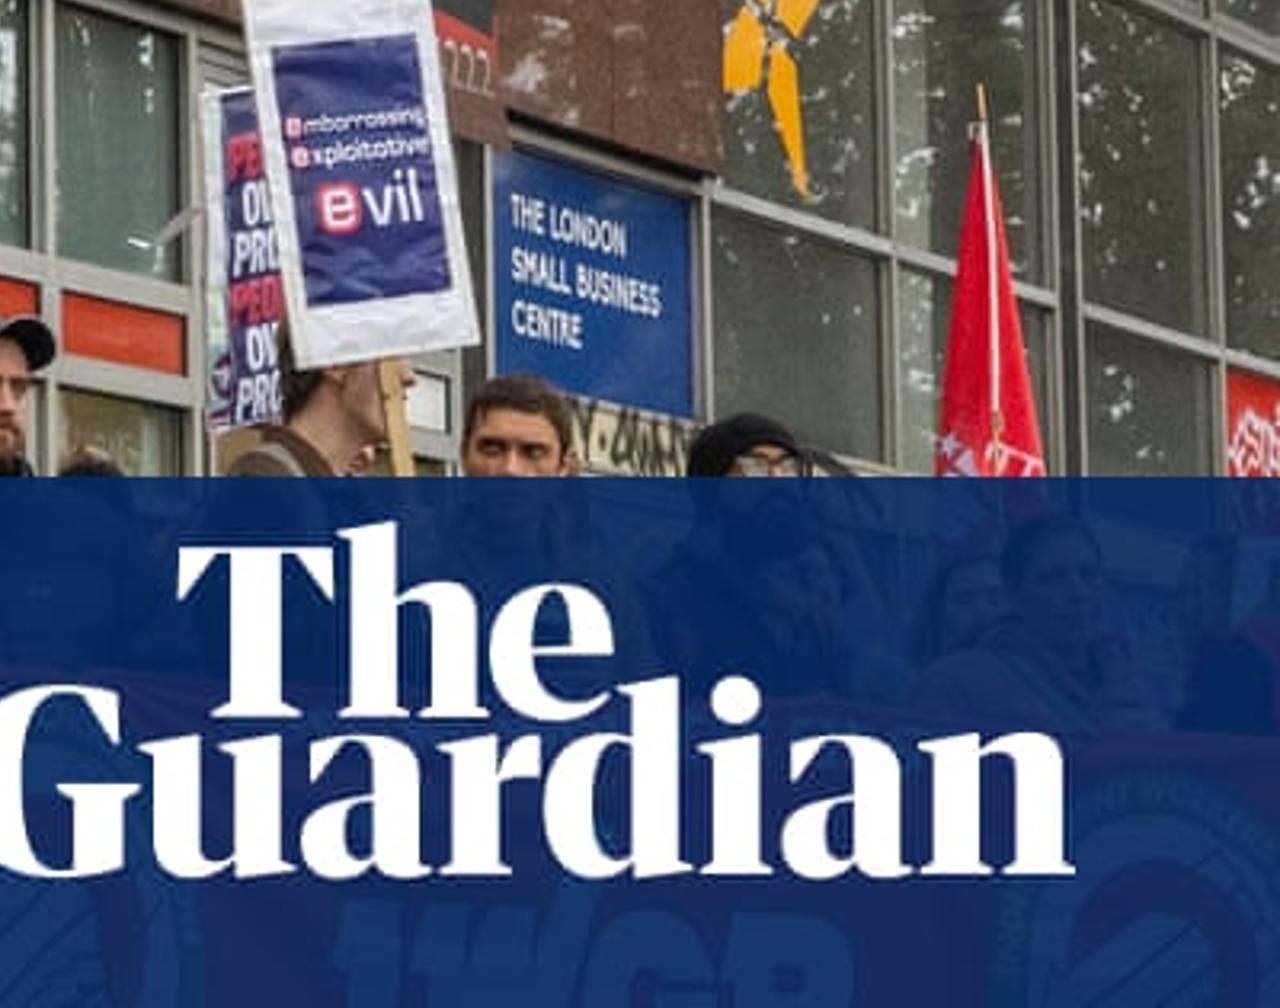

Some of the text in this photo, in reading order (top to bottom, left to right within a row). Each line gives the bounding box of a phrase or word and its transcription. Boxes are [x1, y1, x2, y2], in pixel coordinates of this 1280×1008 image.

[319, 168, 424, 231] evil
[510, 194, 626, 257] THE LONDON
[511, 246, 661, 318] SMALL BUSINESS
[512, 301, 583, 349] CENTRE
